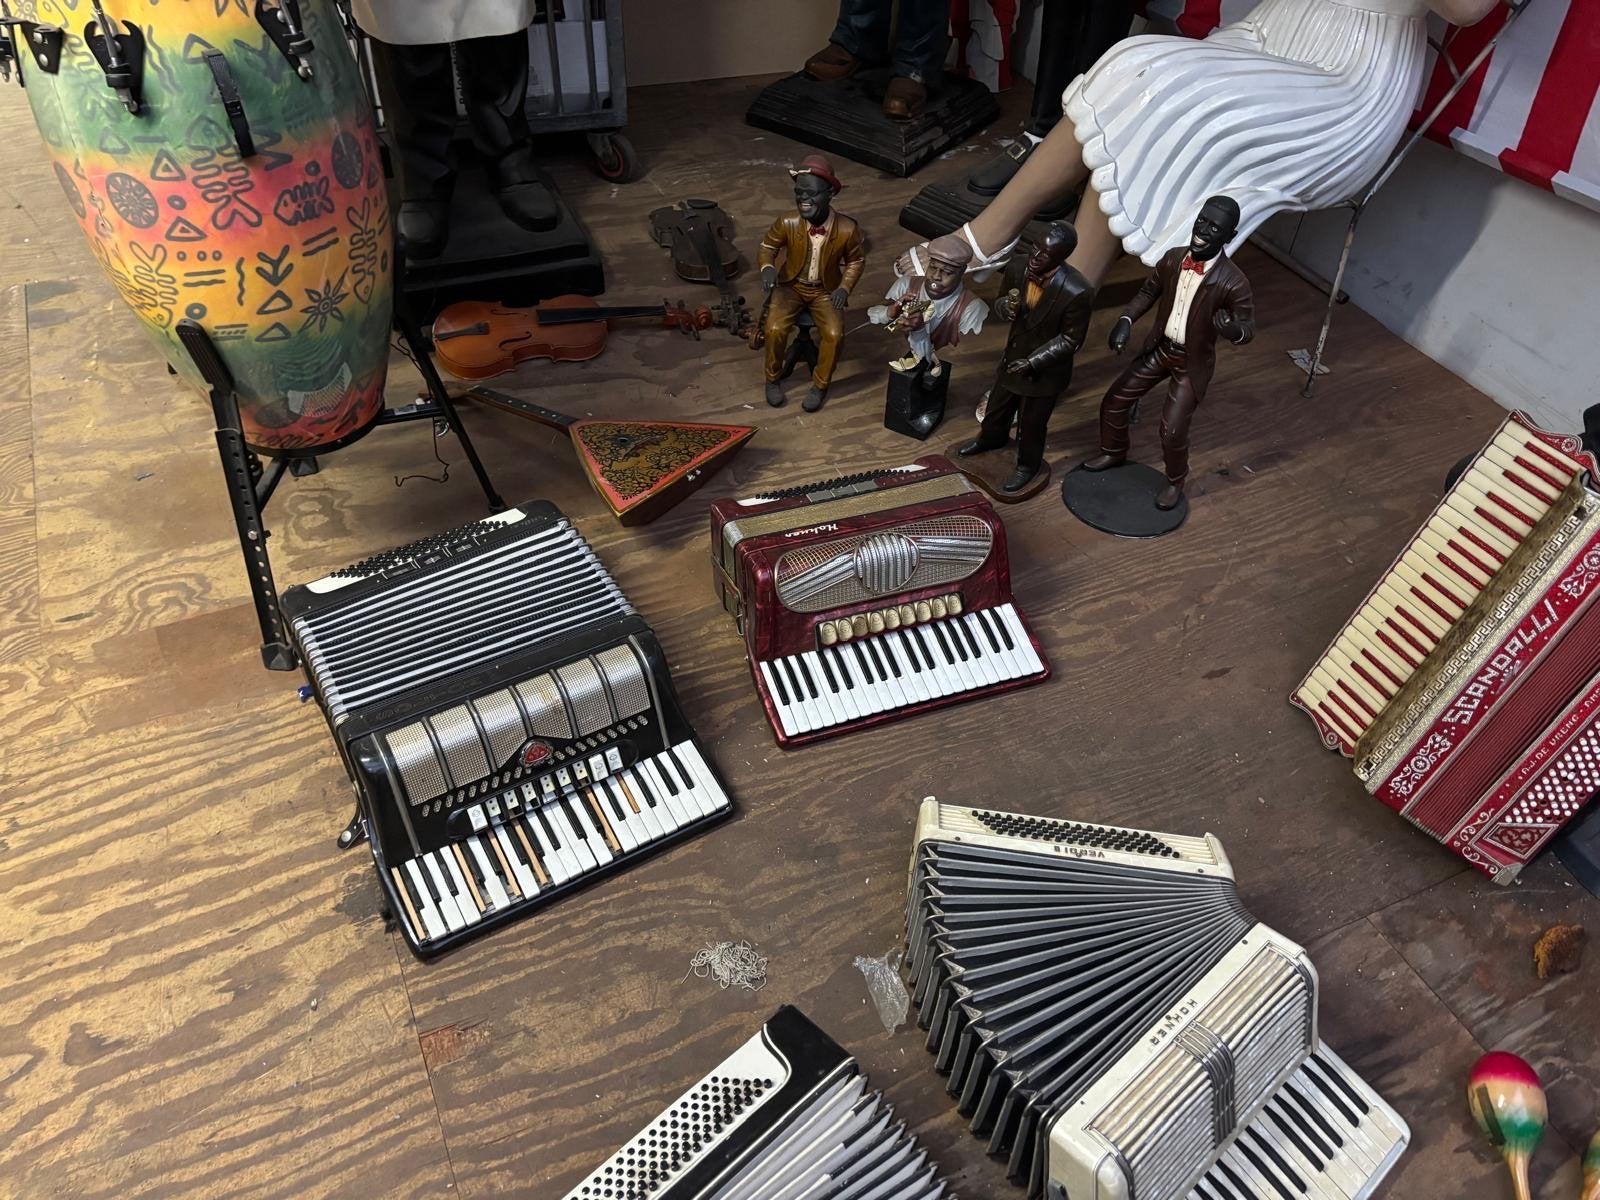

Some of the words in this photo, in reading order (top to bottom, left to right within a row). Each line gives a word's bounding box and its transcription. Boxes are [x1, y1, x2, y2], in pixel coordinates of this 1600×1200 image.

[785, 523, 839, 537] Hohner
[1441, 598, 1560, 725] SCANDALLI
[1150, 999, 1198, 1046] HOHNER
